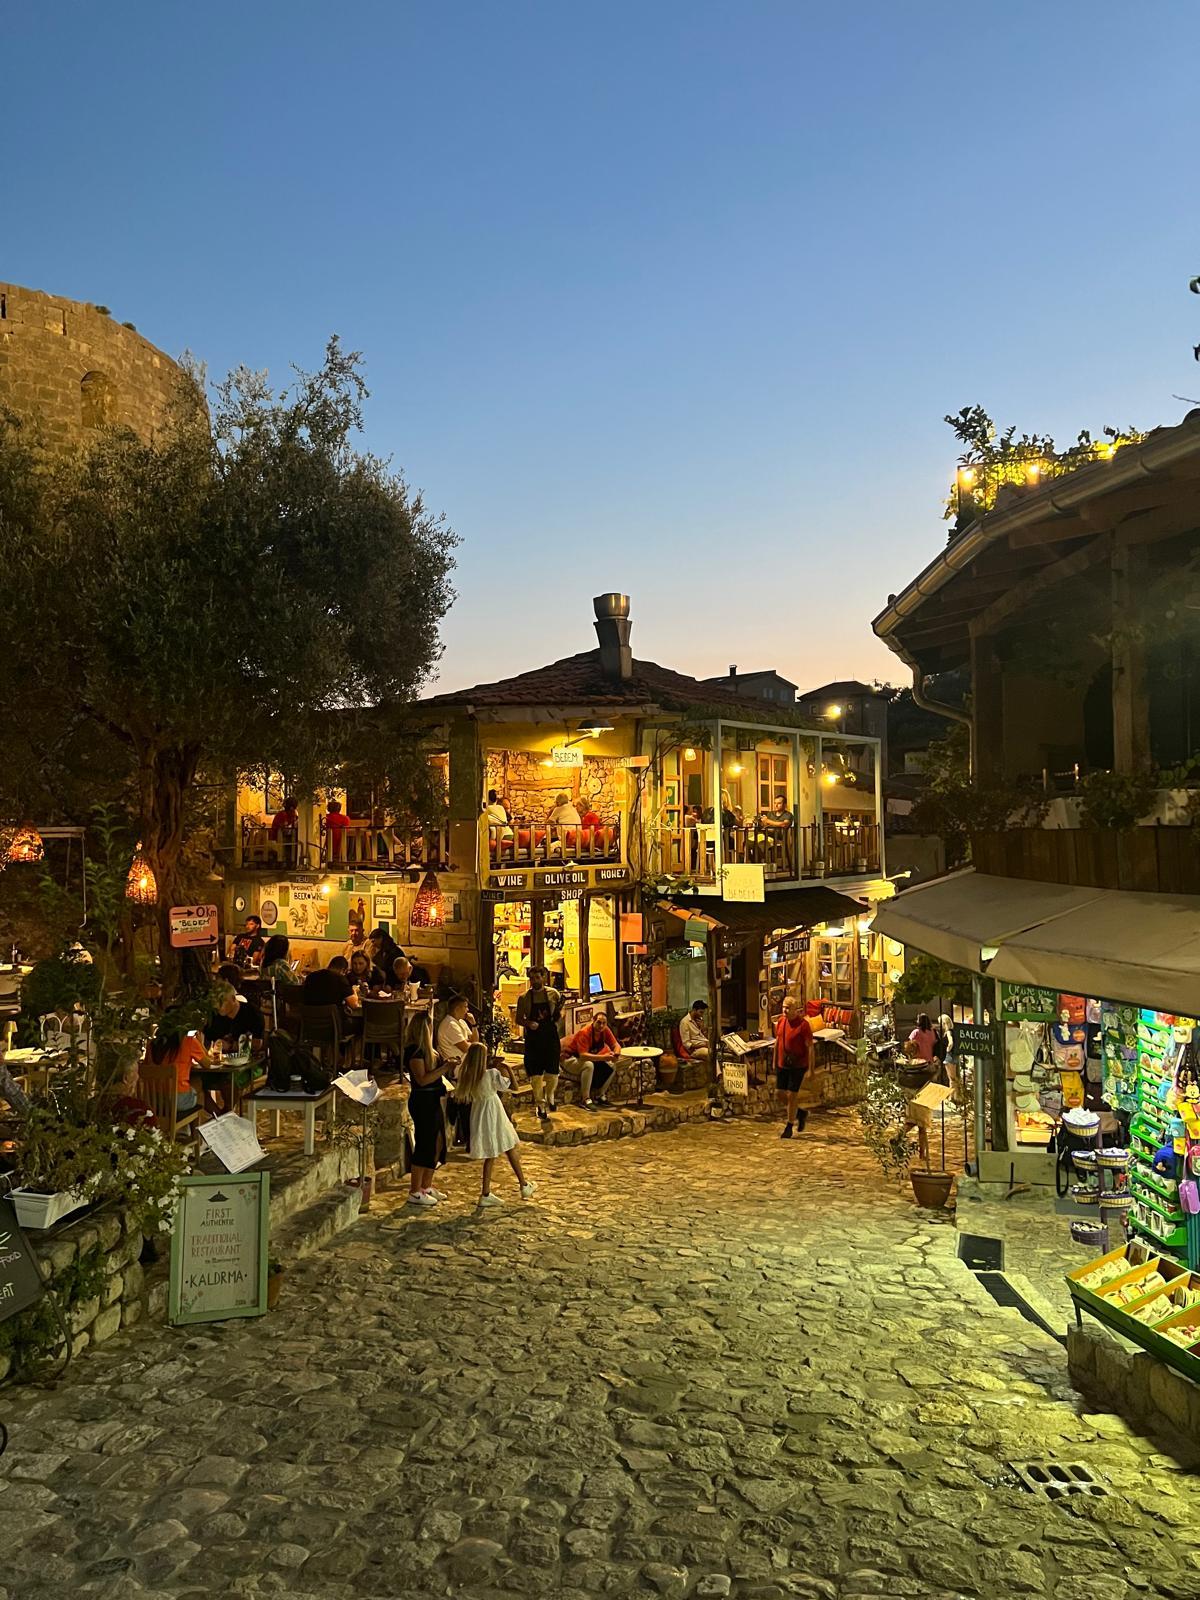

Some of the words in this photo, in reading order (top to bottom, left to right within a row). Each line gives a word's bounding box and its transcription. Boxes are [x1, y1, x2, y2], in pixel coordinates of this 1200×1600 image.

[545, 873, 571, 885] OLIVE
[572, 872, 586, 883] OIL
[601, 868, 626, 880] HONEY
[497, 875, 523, 887] WINE
[561, 889, 583, 900] SHOP
[206, 1207, 232, 1219] FIRST
